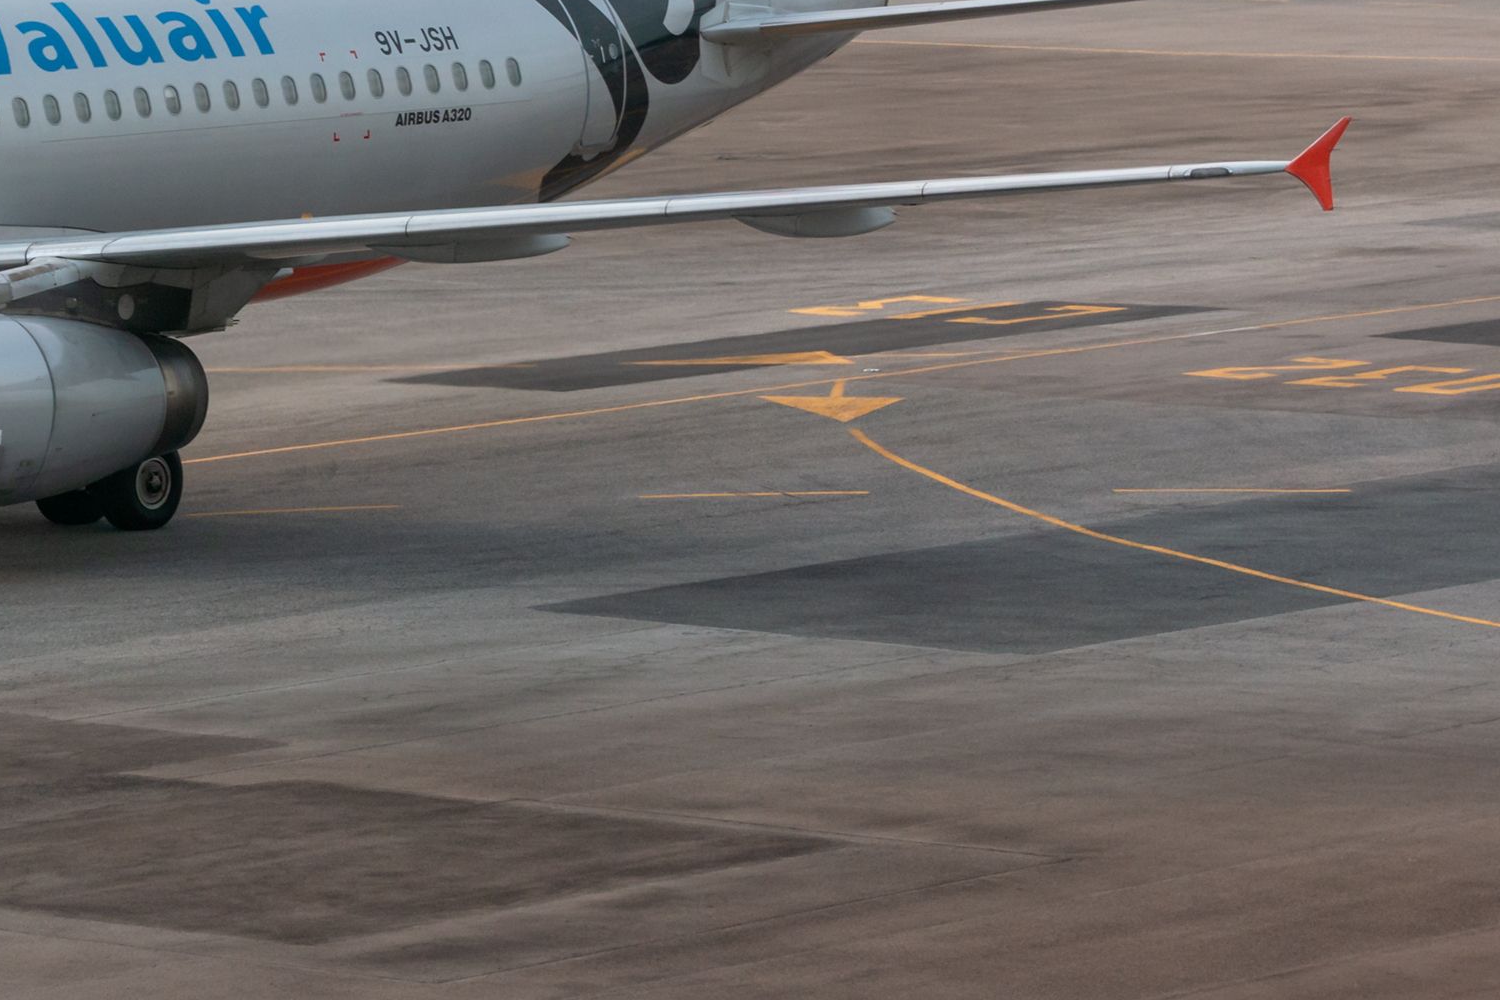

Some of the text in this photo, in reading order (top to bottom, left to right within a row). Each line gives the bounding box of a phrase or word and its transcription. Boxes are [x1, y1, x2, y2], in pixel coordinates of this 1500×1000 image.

[374, 25, 459, 55] 9V-JSH
[394, 106, 472, 127] AIRBUS A320
